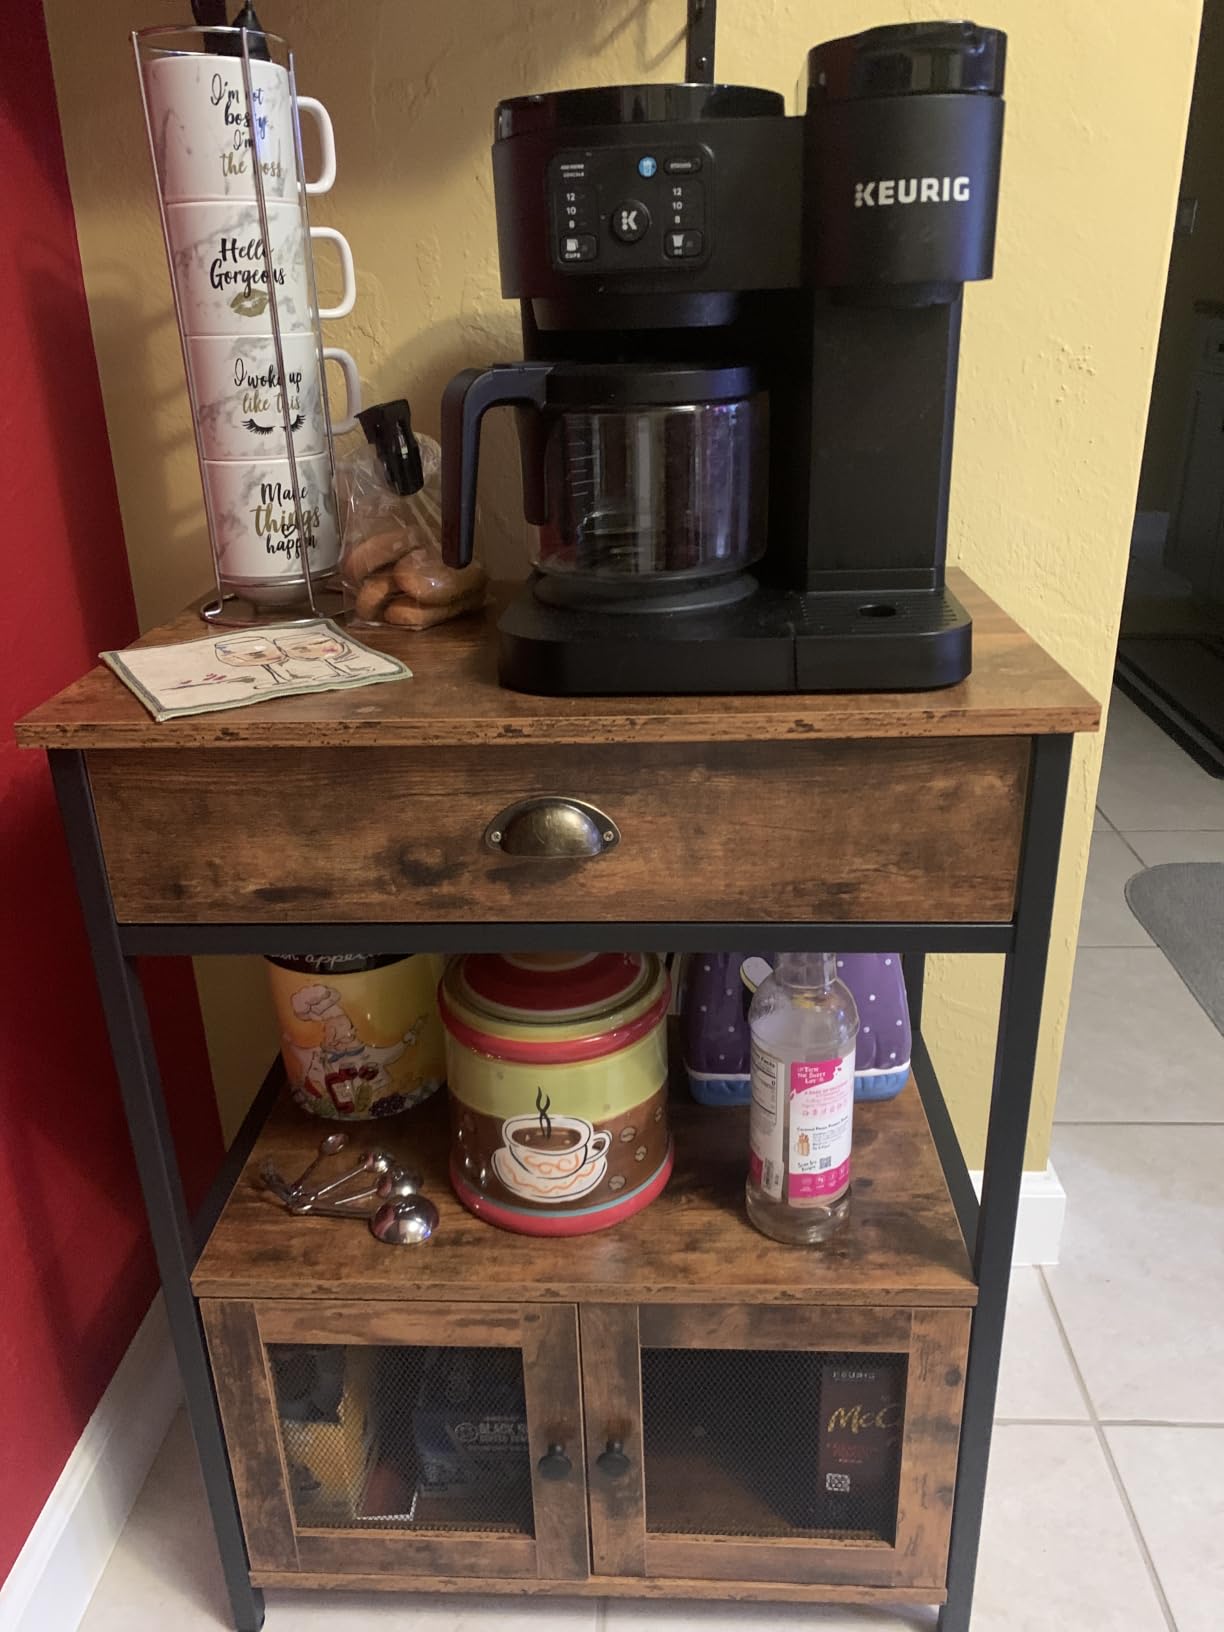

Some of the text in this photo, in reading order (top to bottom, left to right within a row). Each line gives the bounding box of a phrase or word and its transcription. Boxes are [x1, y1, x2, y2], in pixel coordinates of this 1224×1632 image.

[210, 73, 265, 106] I'm ot
[224, 101, 268, 140] bosy
[220, 151, 248, 177] the
[566, 192, 576, 202] 12
[672, 187, 683, 196] 12
[855, 176, 970, 208] KEURIG
[566, 206, 577, 216] 10
[672, 201, 683, 210] 10
[233, 357, 248, 387] I
[288, 371, 302, 393] up
[242, 390, 301, 414] like tis
[260, 482, 309, 508] Mae
[266, 533, 317, 561] happn
